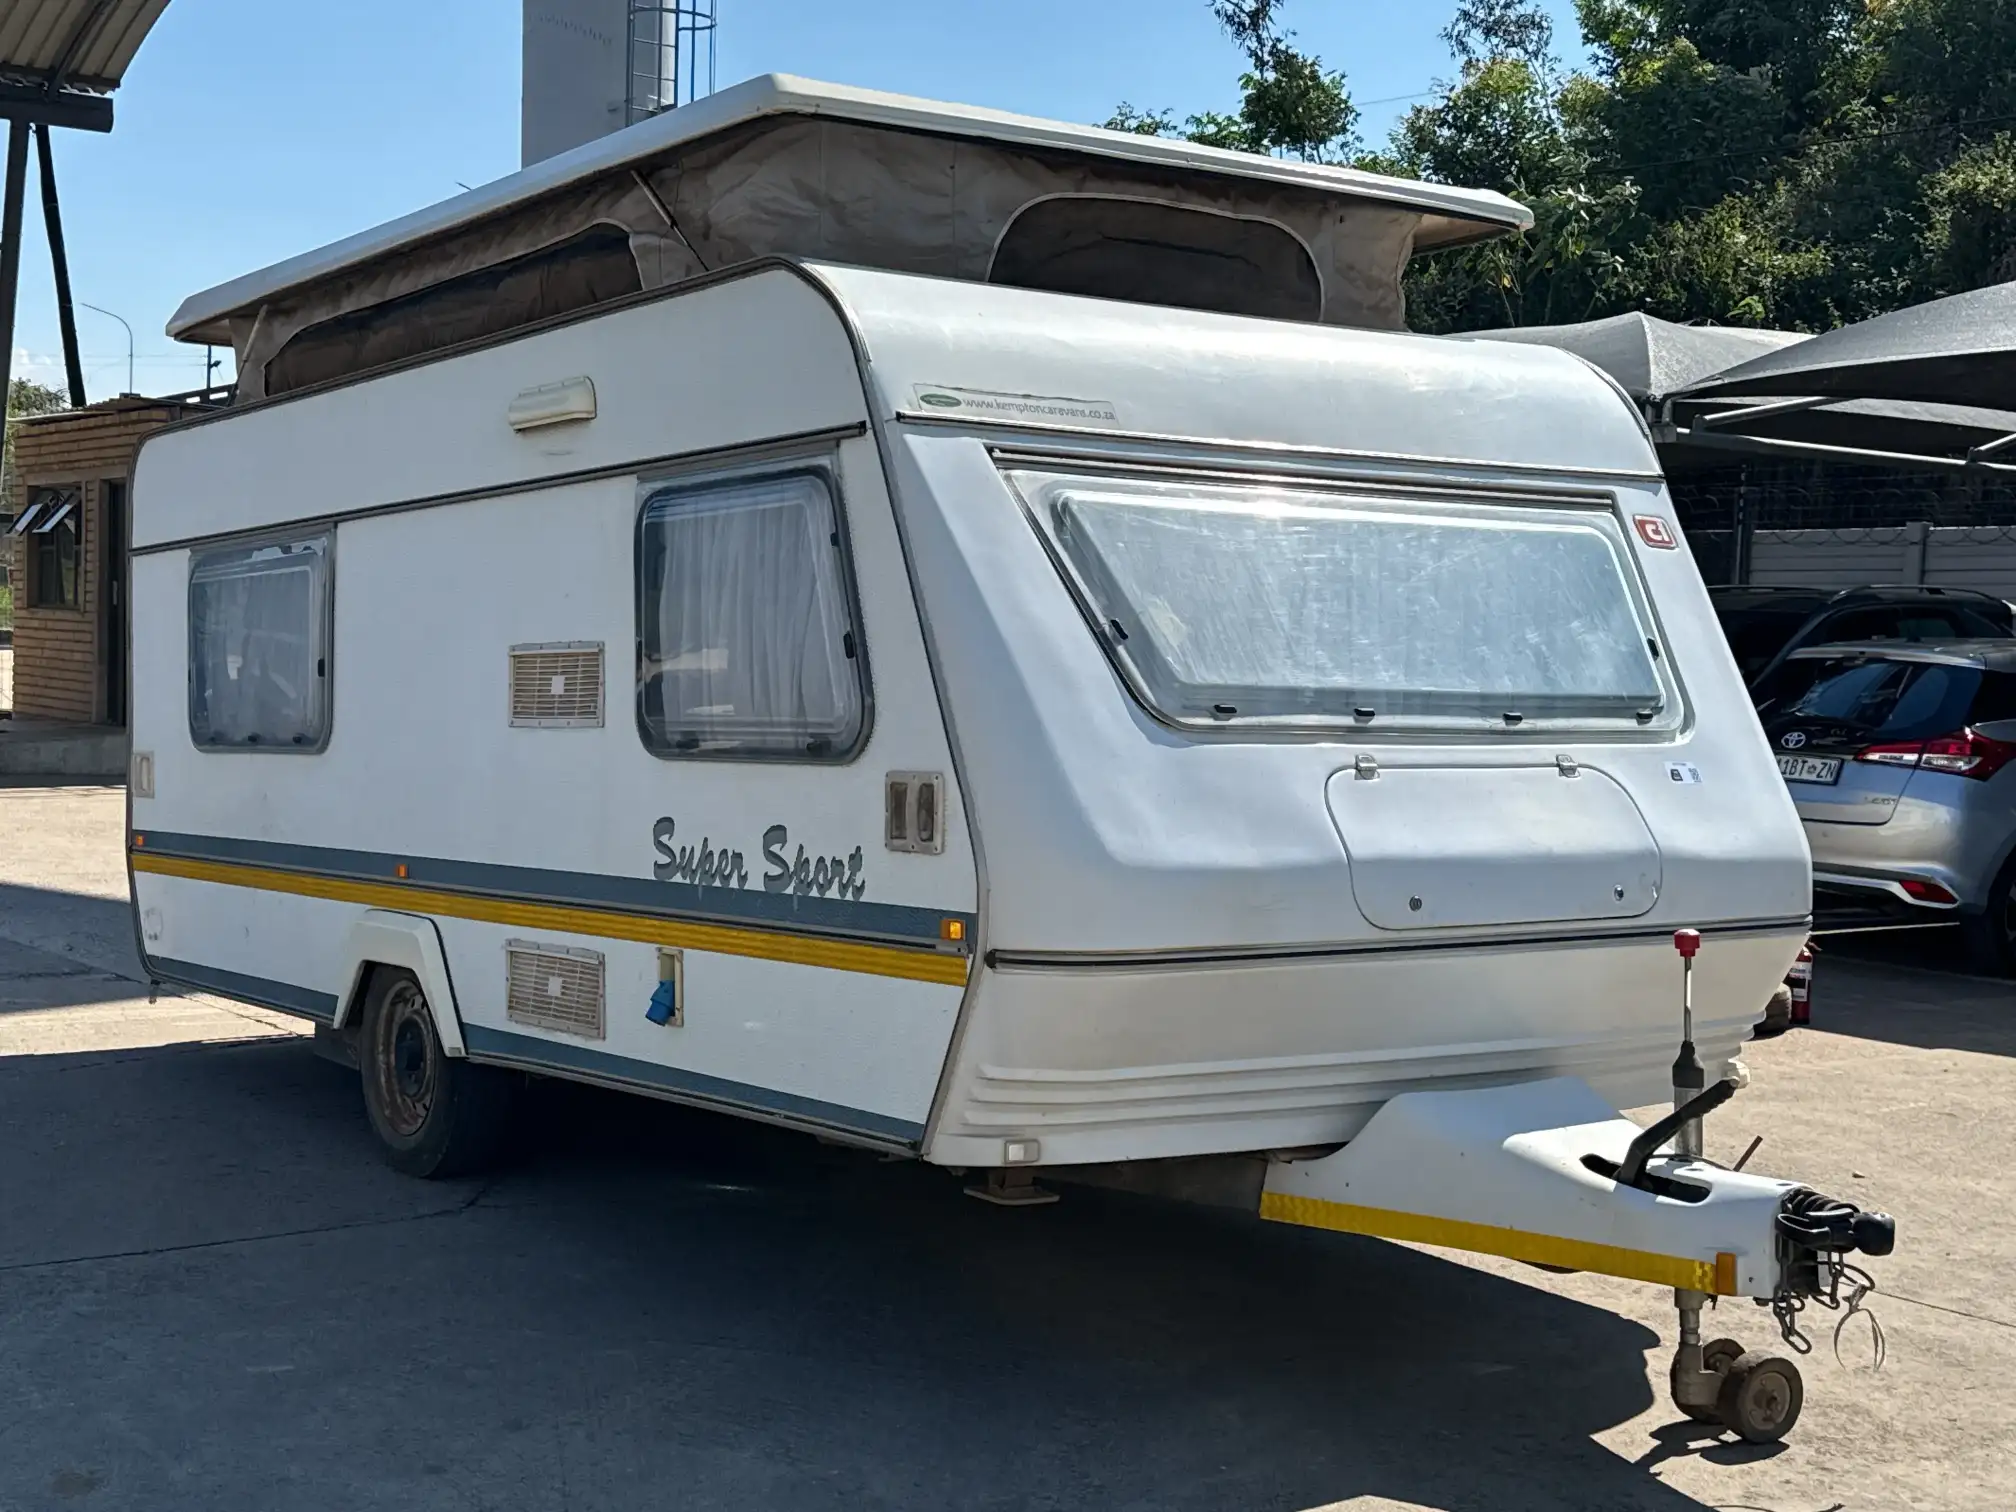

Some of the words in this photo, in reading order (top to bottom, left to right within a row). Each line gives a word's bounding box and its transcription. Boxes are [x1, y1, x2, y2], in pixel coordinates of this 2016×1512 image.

[963, 398, 1116, 420] www.kemptoncaravans.co.za
[1816, 761, 1837, 779] ZN
[653, 816, 748, 897] Super
[763, 824, 865, 908] Sport
